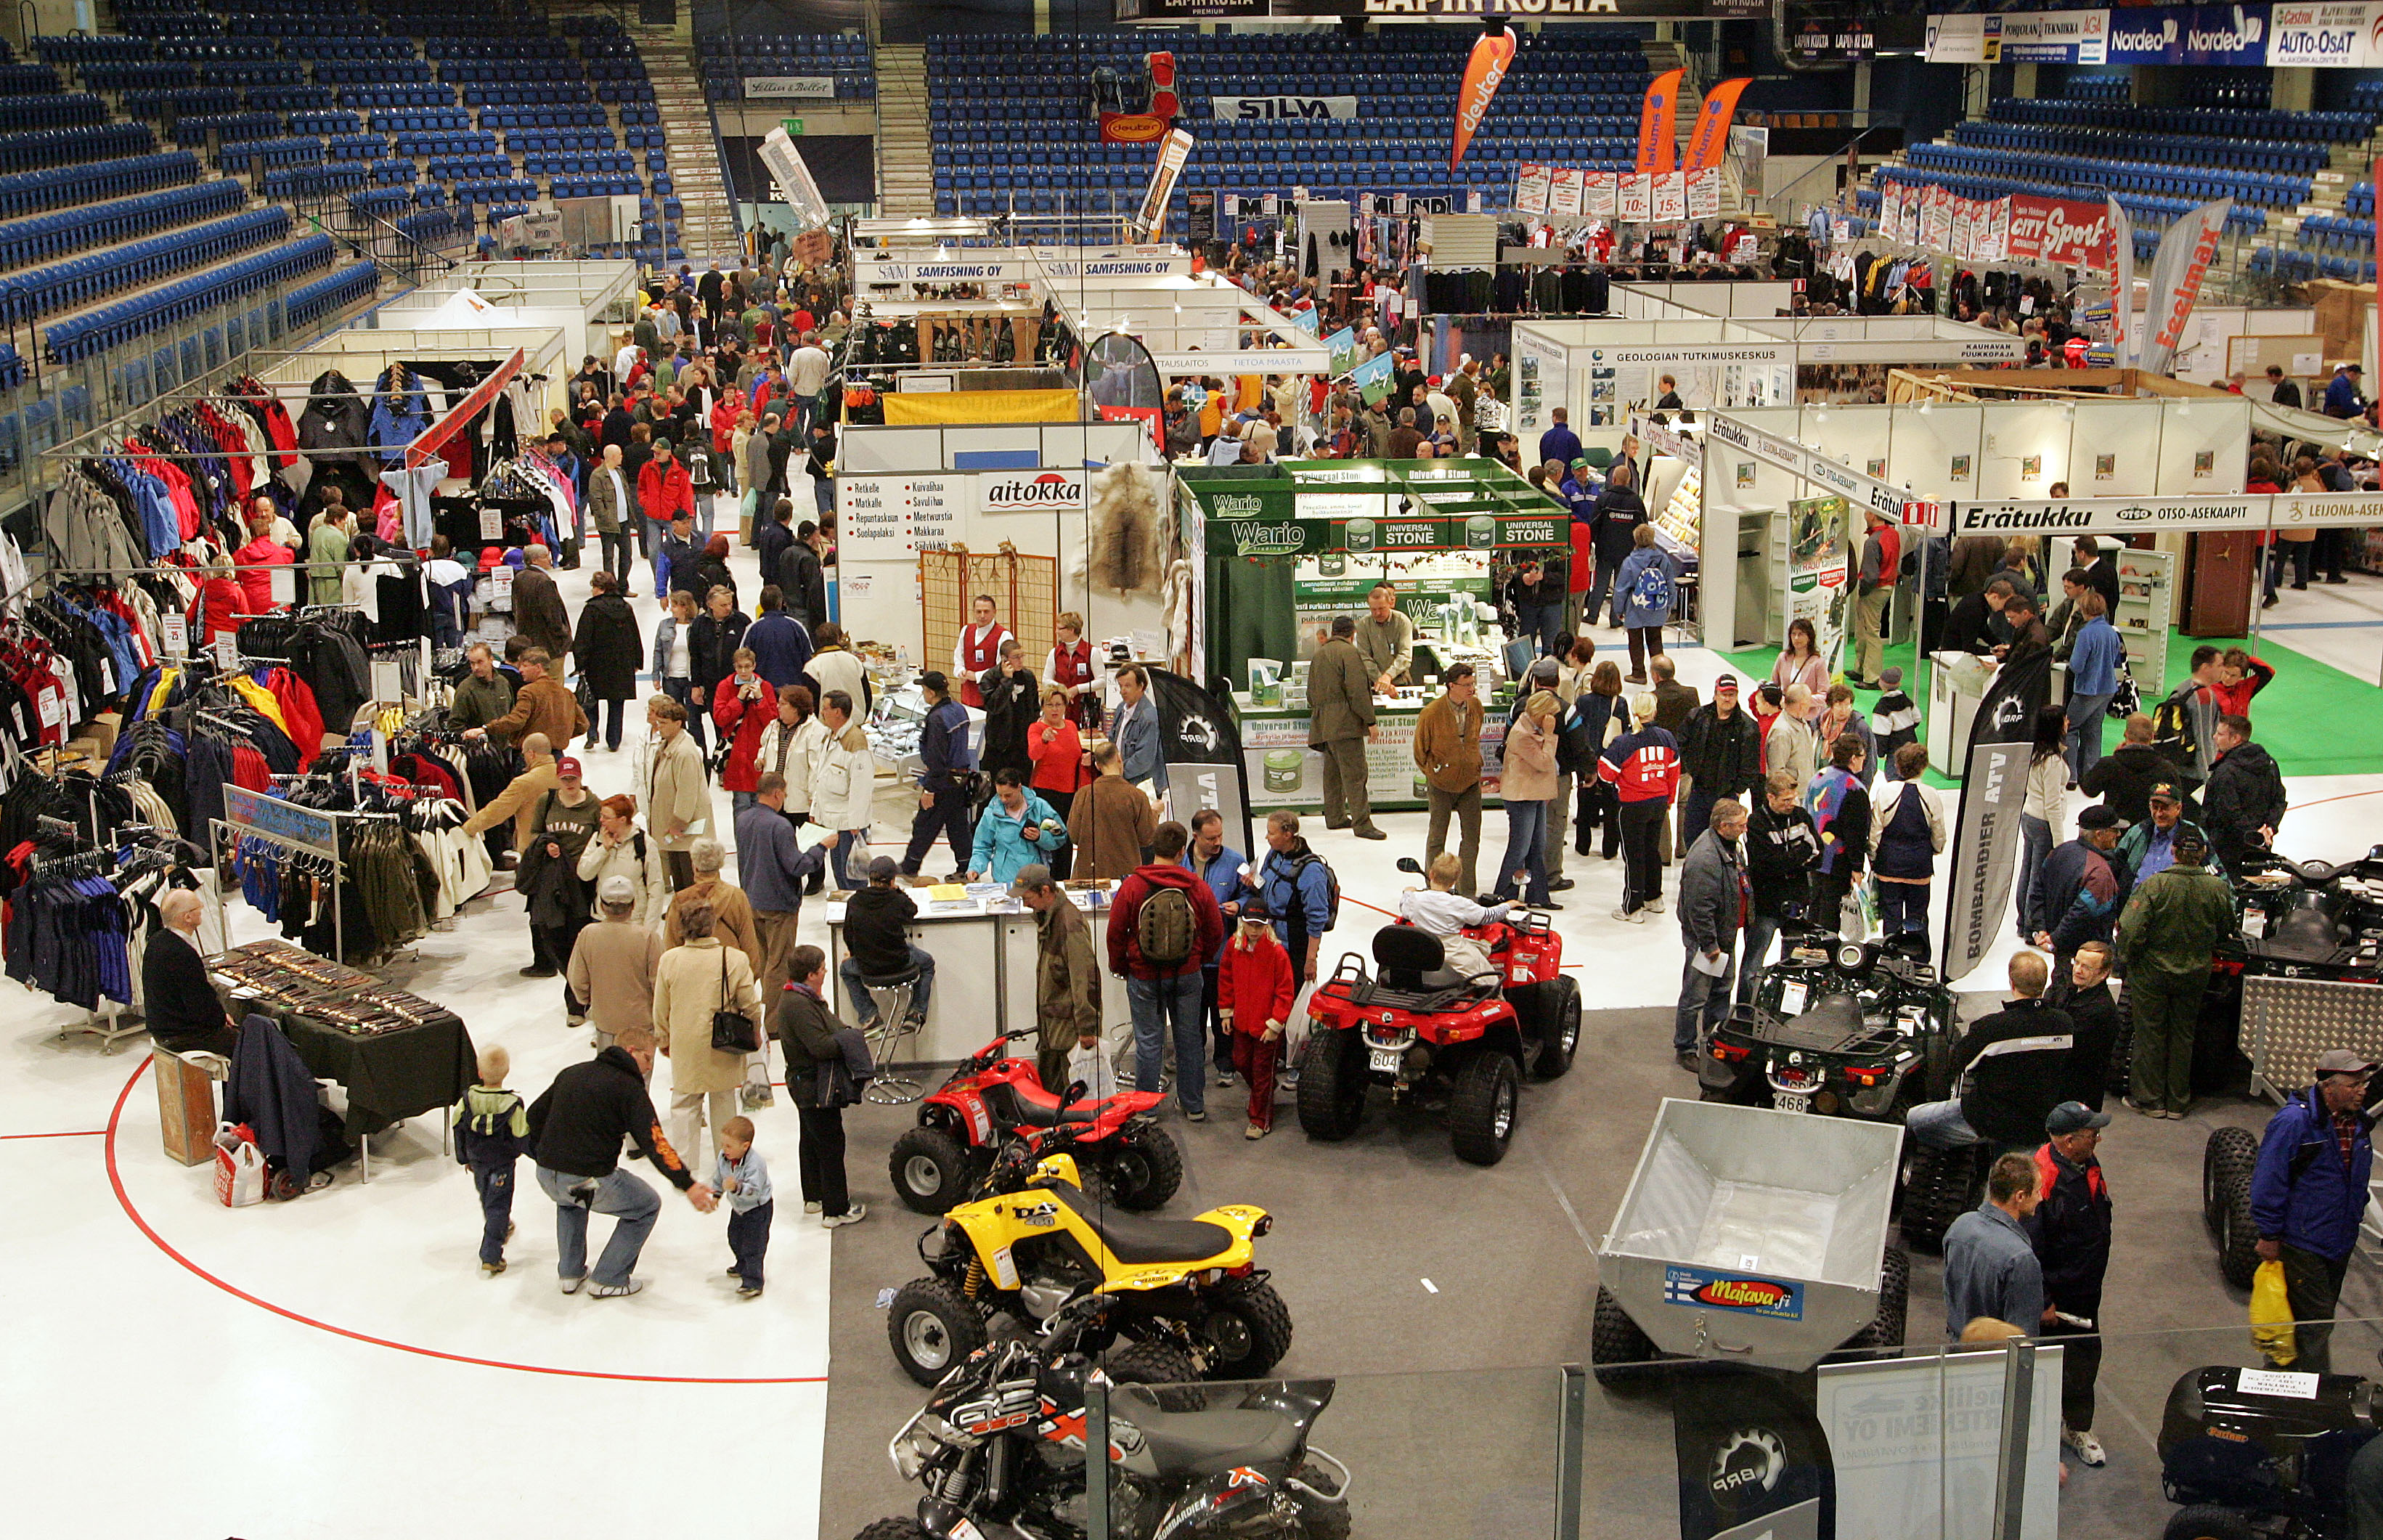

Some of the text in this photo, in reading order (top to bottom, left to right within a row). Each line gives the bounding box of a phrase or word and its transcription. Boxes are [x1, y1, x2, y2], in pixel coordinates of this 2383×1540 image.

[2083, 15, 2102, 35] AGA
[2284, 10, 2313, 26] Castrol
[2005, 23, 2038, 37] POHJOLAN
[1794, 34, 1829, 49] LAPIN KULTA
[2111, 28, 2164, 52] Nordea
[2188, 28, 2245, 52] Nordea
[1461, 58, 1505, 132] deuter
[1238, 98, 1331, 119] SILVA
[1112, 122, 1159, 132] deuter
[1645, 113, 1662, 167] lafuma
[1689, 118, 1716, 170] lafuma
[2011, 218, 2046, 238] CITY
[2045, 207, 2106, 254] Sport
[916, 265, 984, 279] SAMFISHING
[987, 265, 1003, 277] OY
[1085, 262, 1152, 276] SAMFISHING
[1154, 261, 1170, 274] OY
[2155, 227, 2221, 349] Feelmax
[1157, 357, 1303, 368] TTAUSLAITOS TIETOA MAASTA
[1616, 350, 1777, 362] GEOLOGIAN TUTKIMUSKESKUS
[1713, 417, 1750, 449] Erätukku
[855, 483, 880, 494] Retkelle
[988, 481, 1081, 502] aitokka
[855, 497, 882, 509] Matkalle
[1213, 494, 1262, 510] Wario
[1870, 486, 1903, 518] Erätu
[913, 511, 953, 523] Meetwurstia
[1963, 506, 2093, 530] Erätukku
[2119, 506, 2248, 520] OTSO OTSO-ASEKAAPIT
[914, 526, 945, 537] Makkaraa
[1231, 521, 1305, 545] Wario
[1386, 523, 1435, 532] UNIVERSAL
[1506, 521, 1554, 530] UNIVERSAL
[1385, 532, 1435, 545] STONE
[1506, 529, 1555, 542] STONE
[1251, 720, 1310, 731] Universal Sto
[1984, 752, 2007, 804] ATV
[545, 820, 585, 834] MIAMI
[1966, 812, 1997, 961] BOMBARDIER
[1374, 1054, 1398, 1072] 604
[1778, 1096, 1804, 1112] 468
[1711, 1279, 1774, 1305] Majava
